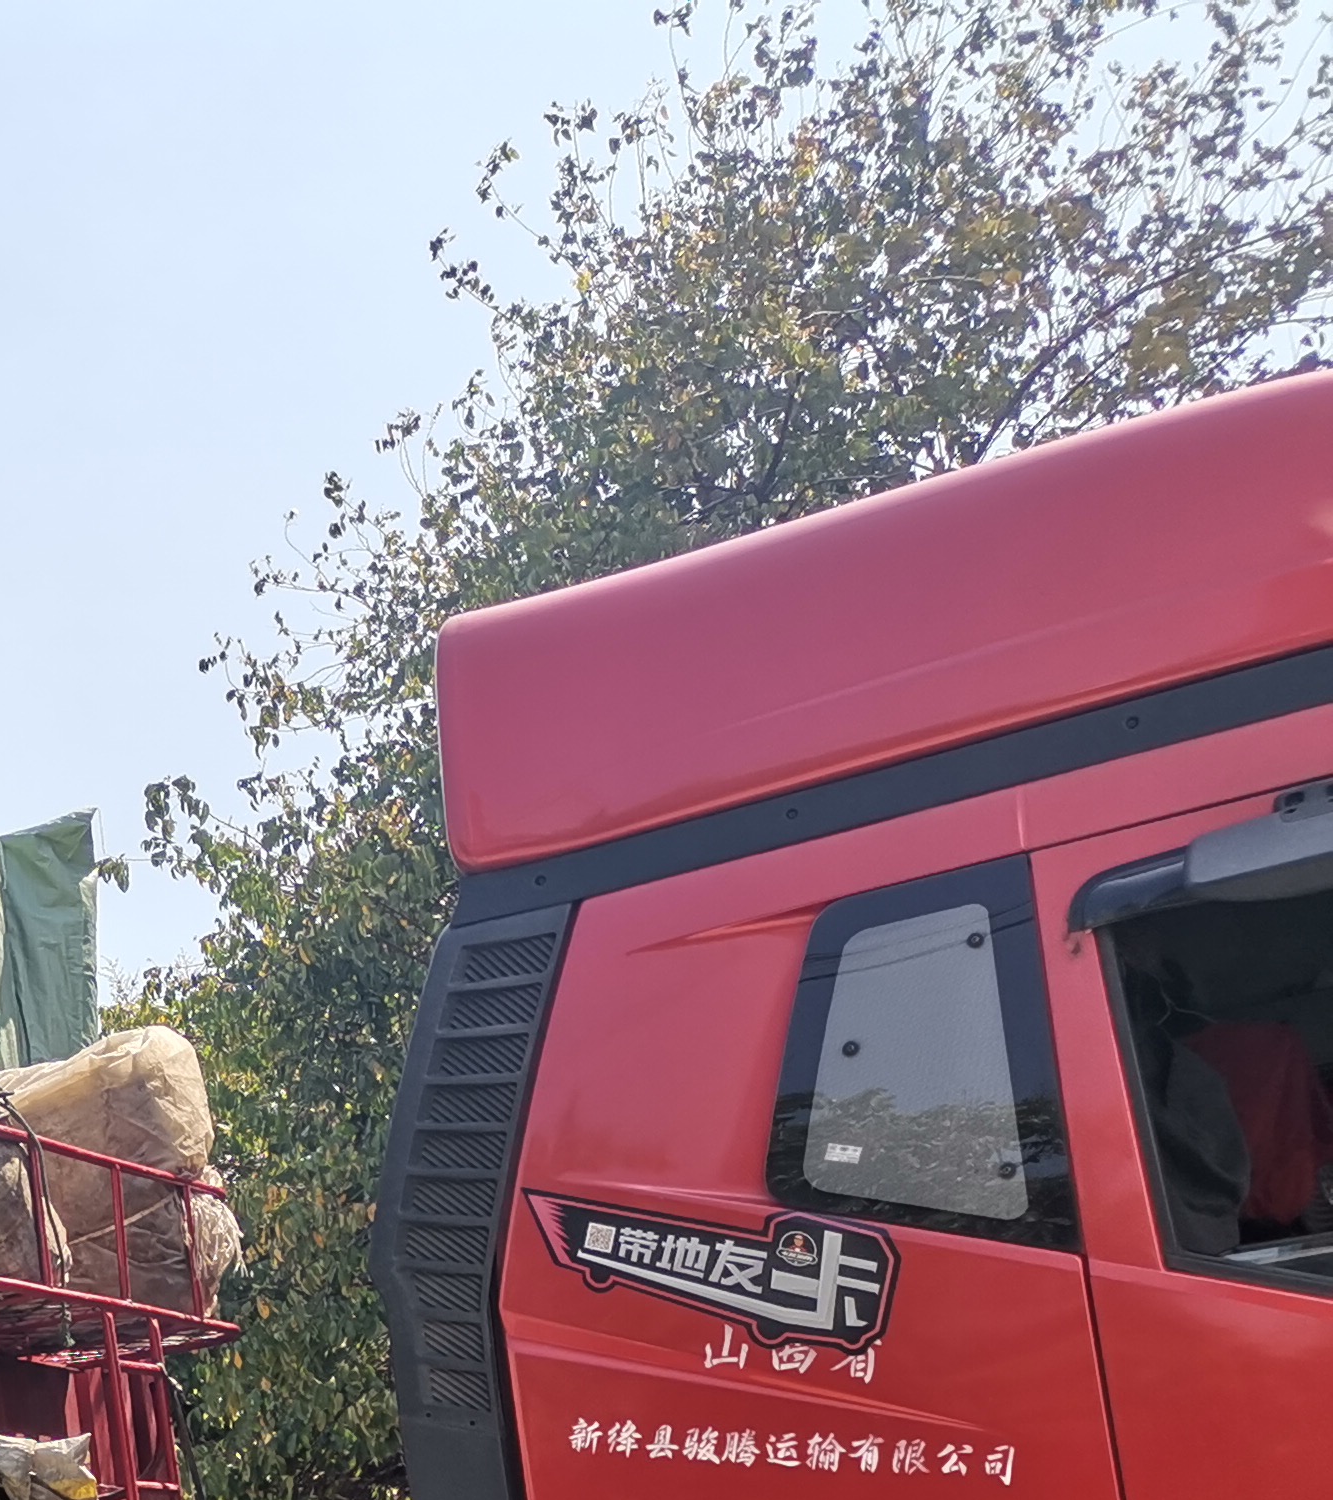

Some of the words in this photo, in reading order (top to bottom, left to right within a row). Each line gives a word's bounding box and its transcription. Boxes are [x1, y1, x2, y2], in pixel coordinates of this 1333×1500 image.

[567, 1416, 1016, 1486] 新绛县骏腾运输有限公司
